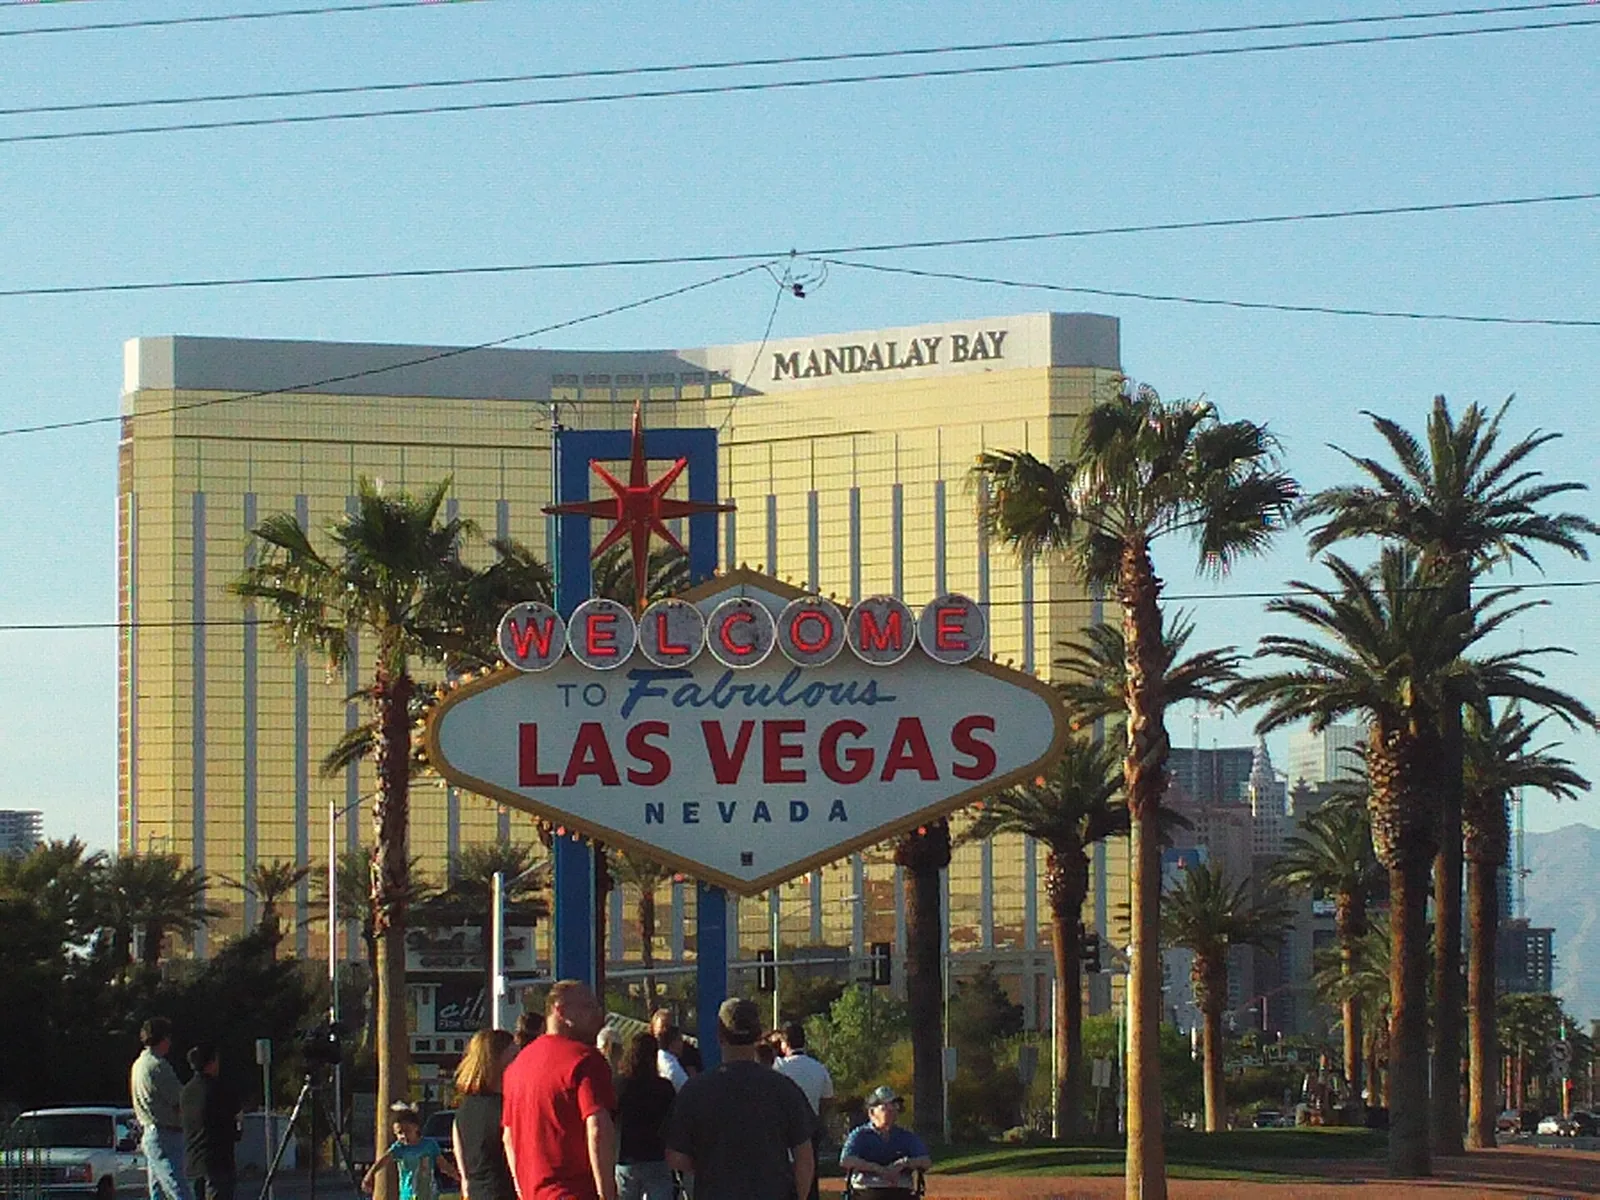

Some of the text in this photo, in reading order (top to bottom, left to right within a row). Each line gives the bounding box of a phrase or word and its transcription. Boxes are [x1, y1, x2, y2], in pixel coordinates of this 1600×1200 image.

[772, 330, 1008, 381] MANDALAY BAY
[507, 606, 969, 659] WELCOME
[557, 667, 897, 720] TO Fabulous
[517, 714, 998, 787] LAS VEGAS
[644, 799, 849, 825] NEVADA
